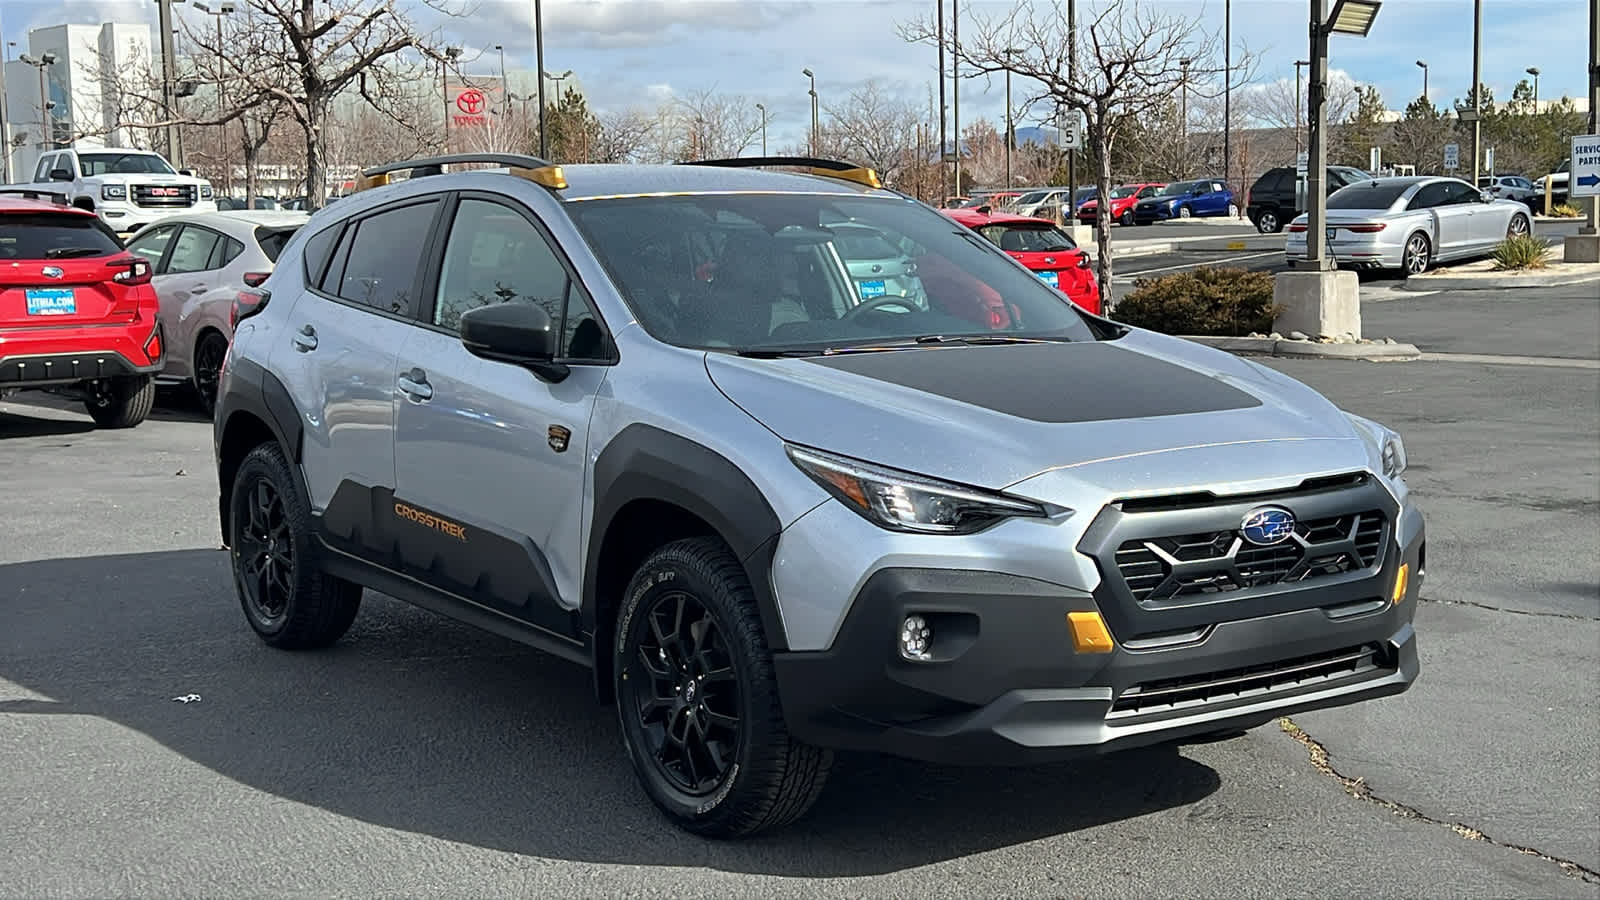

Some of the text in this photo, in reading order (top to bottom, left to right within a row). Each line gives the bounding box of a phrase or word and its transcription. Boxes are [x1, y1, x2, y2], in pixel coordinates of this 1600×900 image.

[453, 115, 494, 126] TOYOT
[1065, 130, 1074, 144] 5
[151, 187, 179, 196] GMC
[394, 503, 466, 541] CROSSTREK
